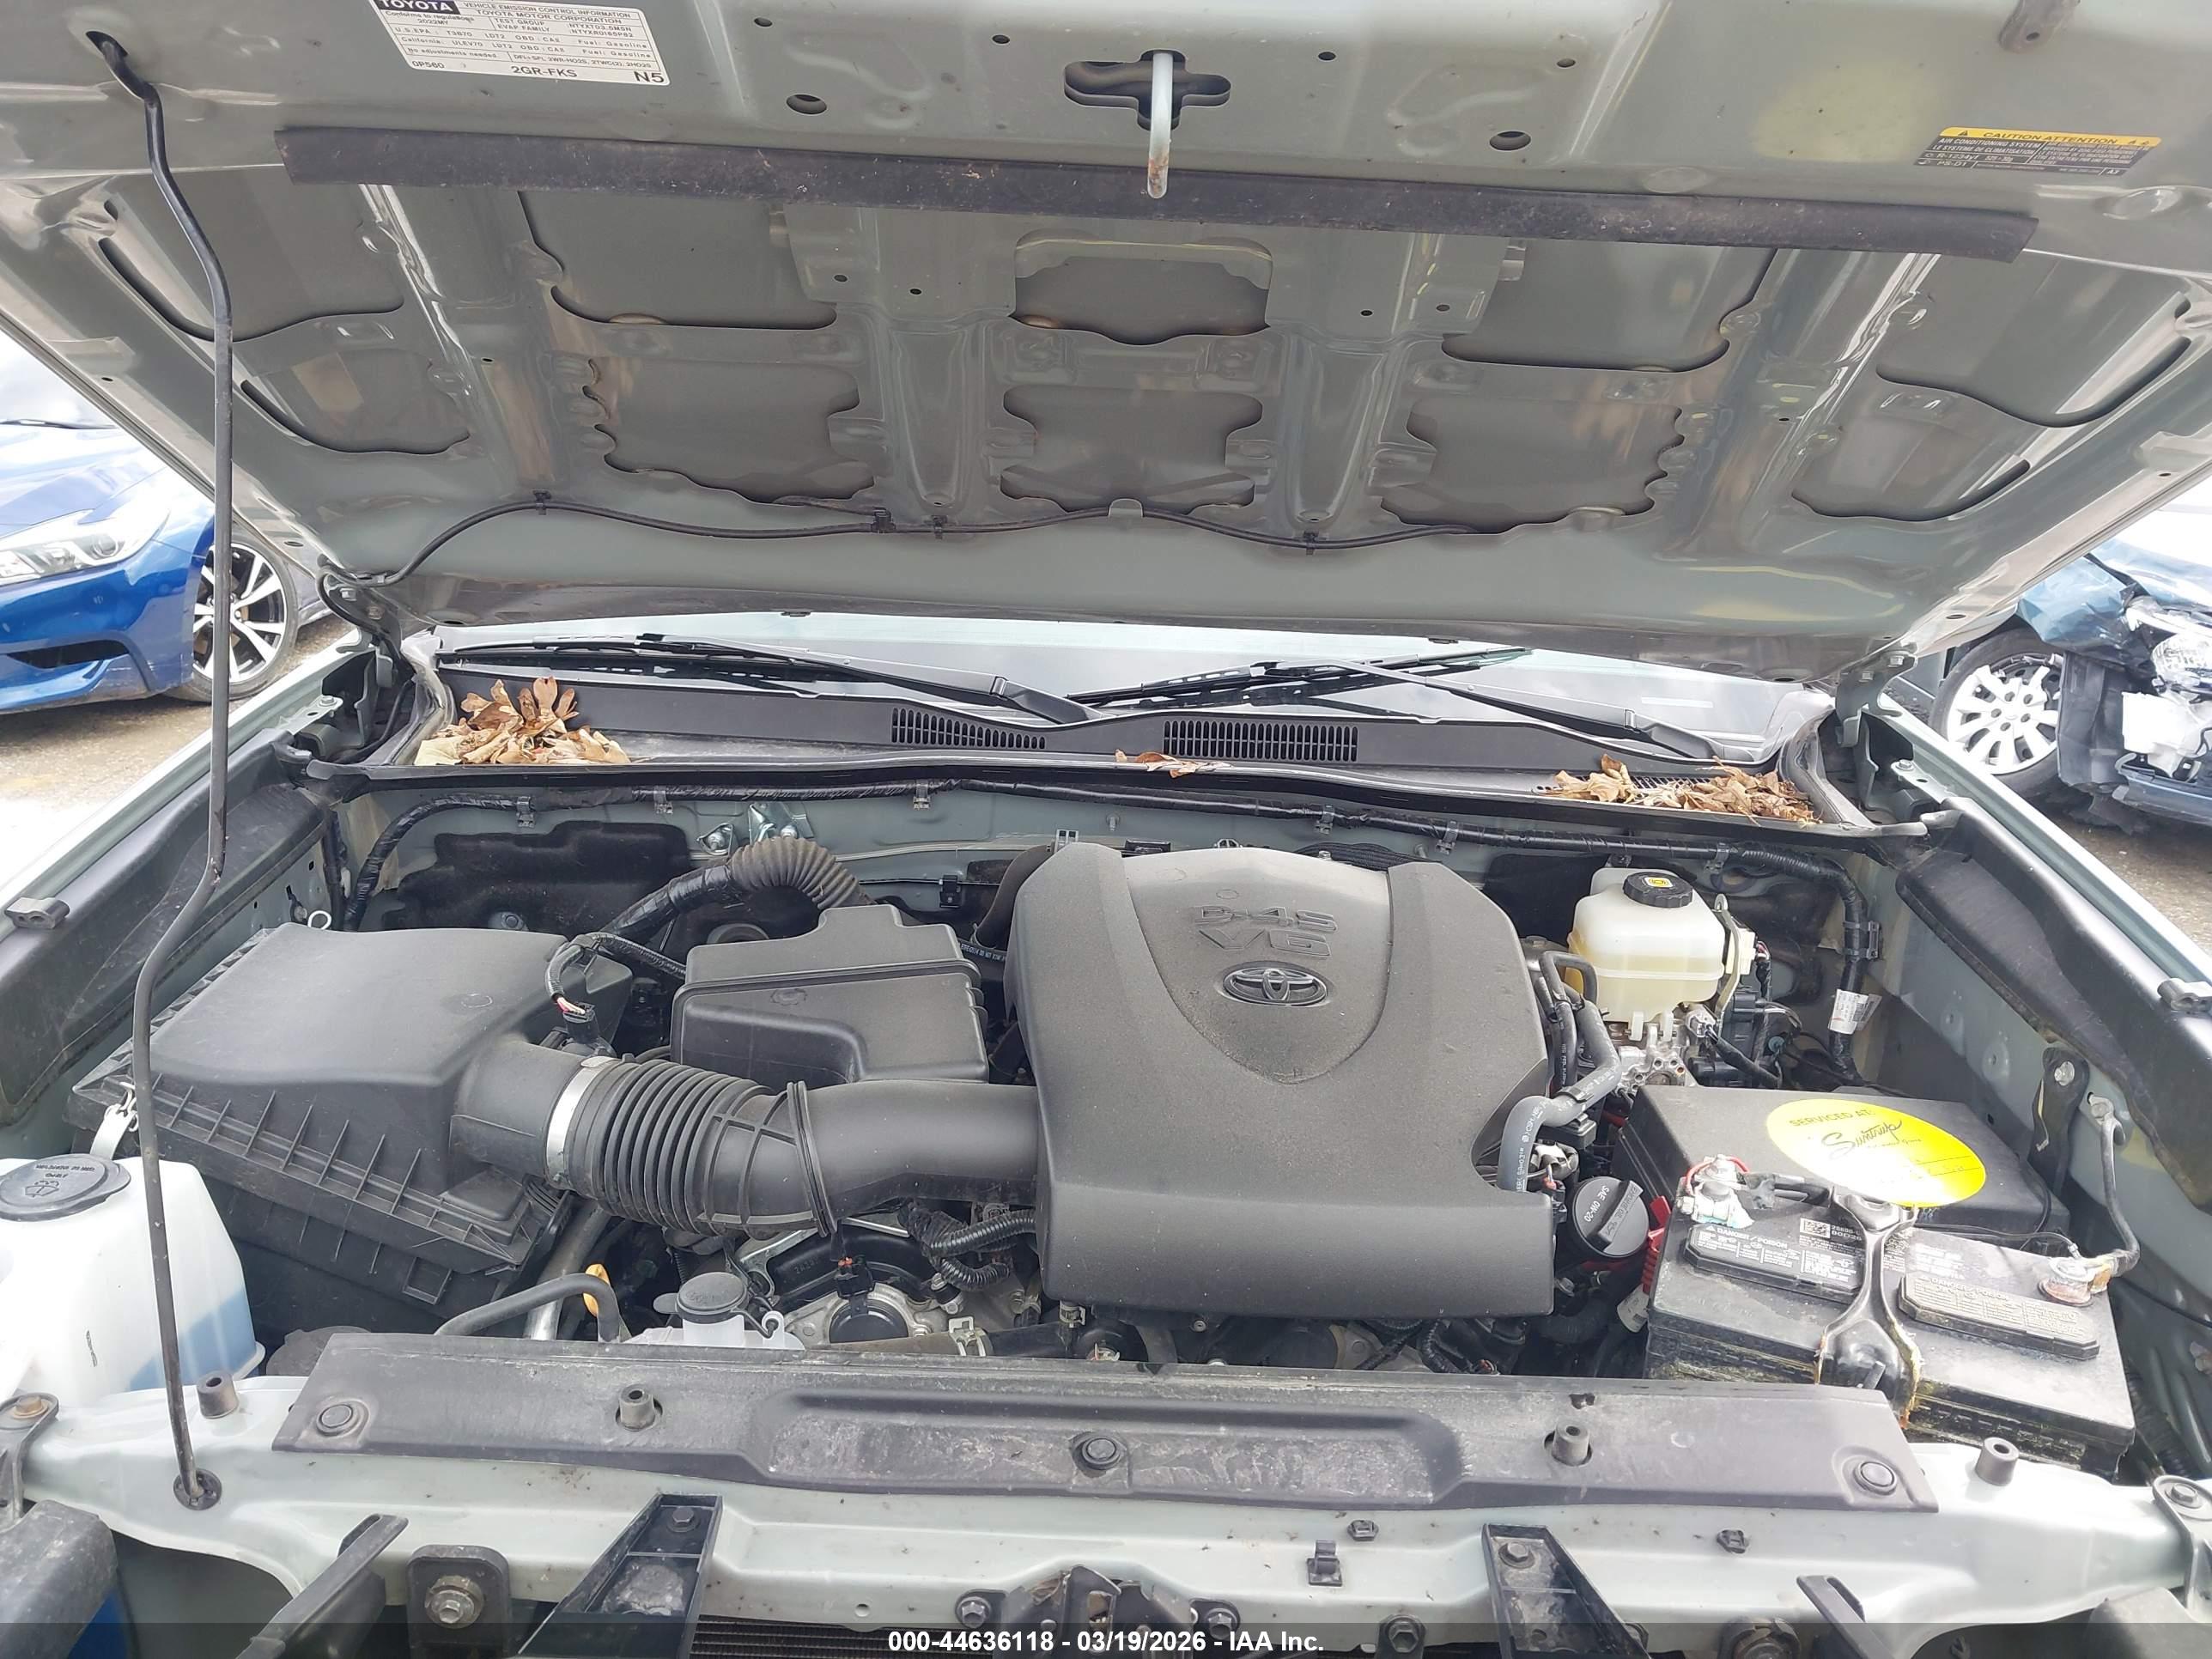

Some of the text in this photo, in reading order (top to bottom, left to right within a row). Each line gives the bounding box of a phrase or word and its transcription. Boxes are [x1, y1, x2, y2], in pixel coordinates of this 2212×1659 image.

[382, 0, 453, 12] TOYOTA
[554, 15, 622, 24] CORPORATION
[511, 65, 577, 77] 2GR-FKS
[634, 70, 665, 83] N5
[1954, 138, 2008, 147] CONDITIONING
[1983, 132, 2118, 144] CAUTION ATTENTION
[1199, 928, 1331, 958] V6
[1790, 1110, 1853, 1127] SERVICED
[1583, 1185, 1610, 1222] SAE 0W-20
[1717, 1227, 1750, 1241] DANGER
[1757, 1237, 1788, 1249] POISON
